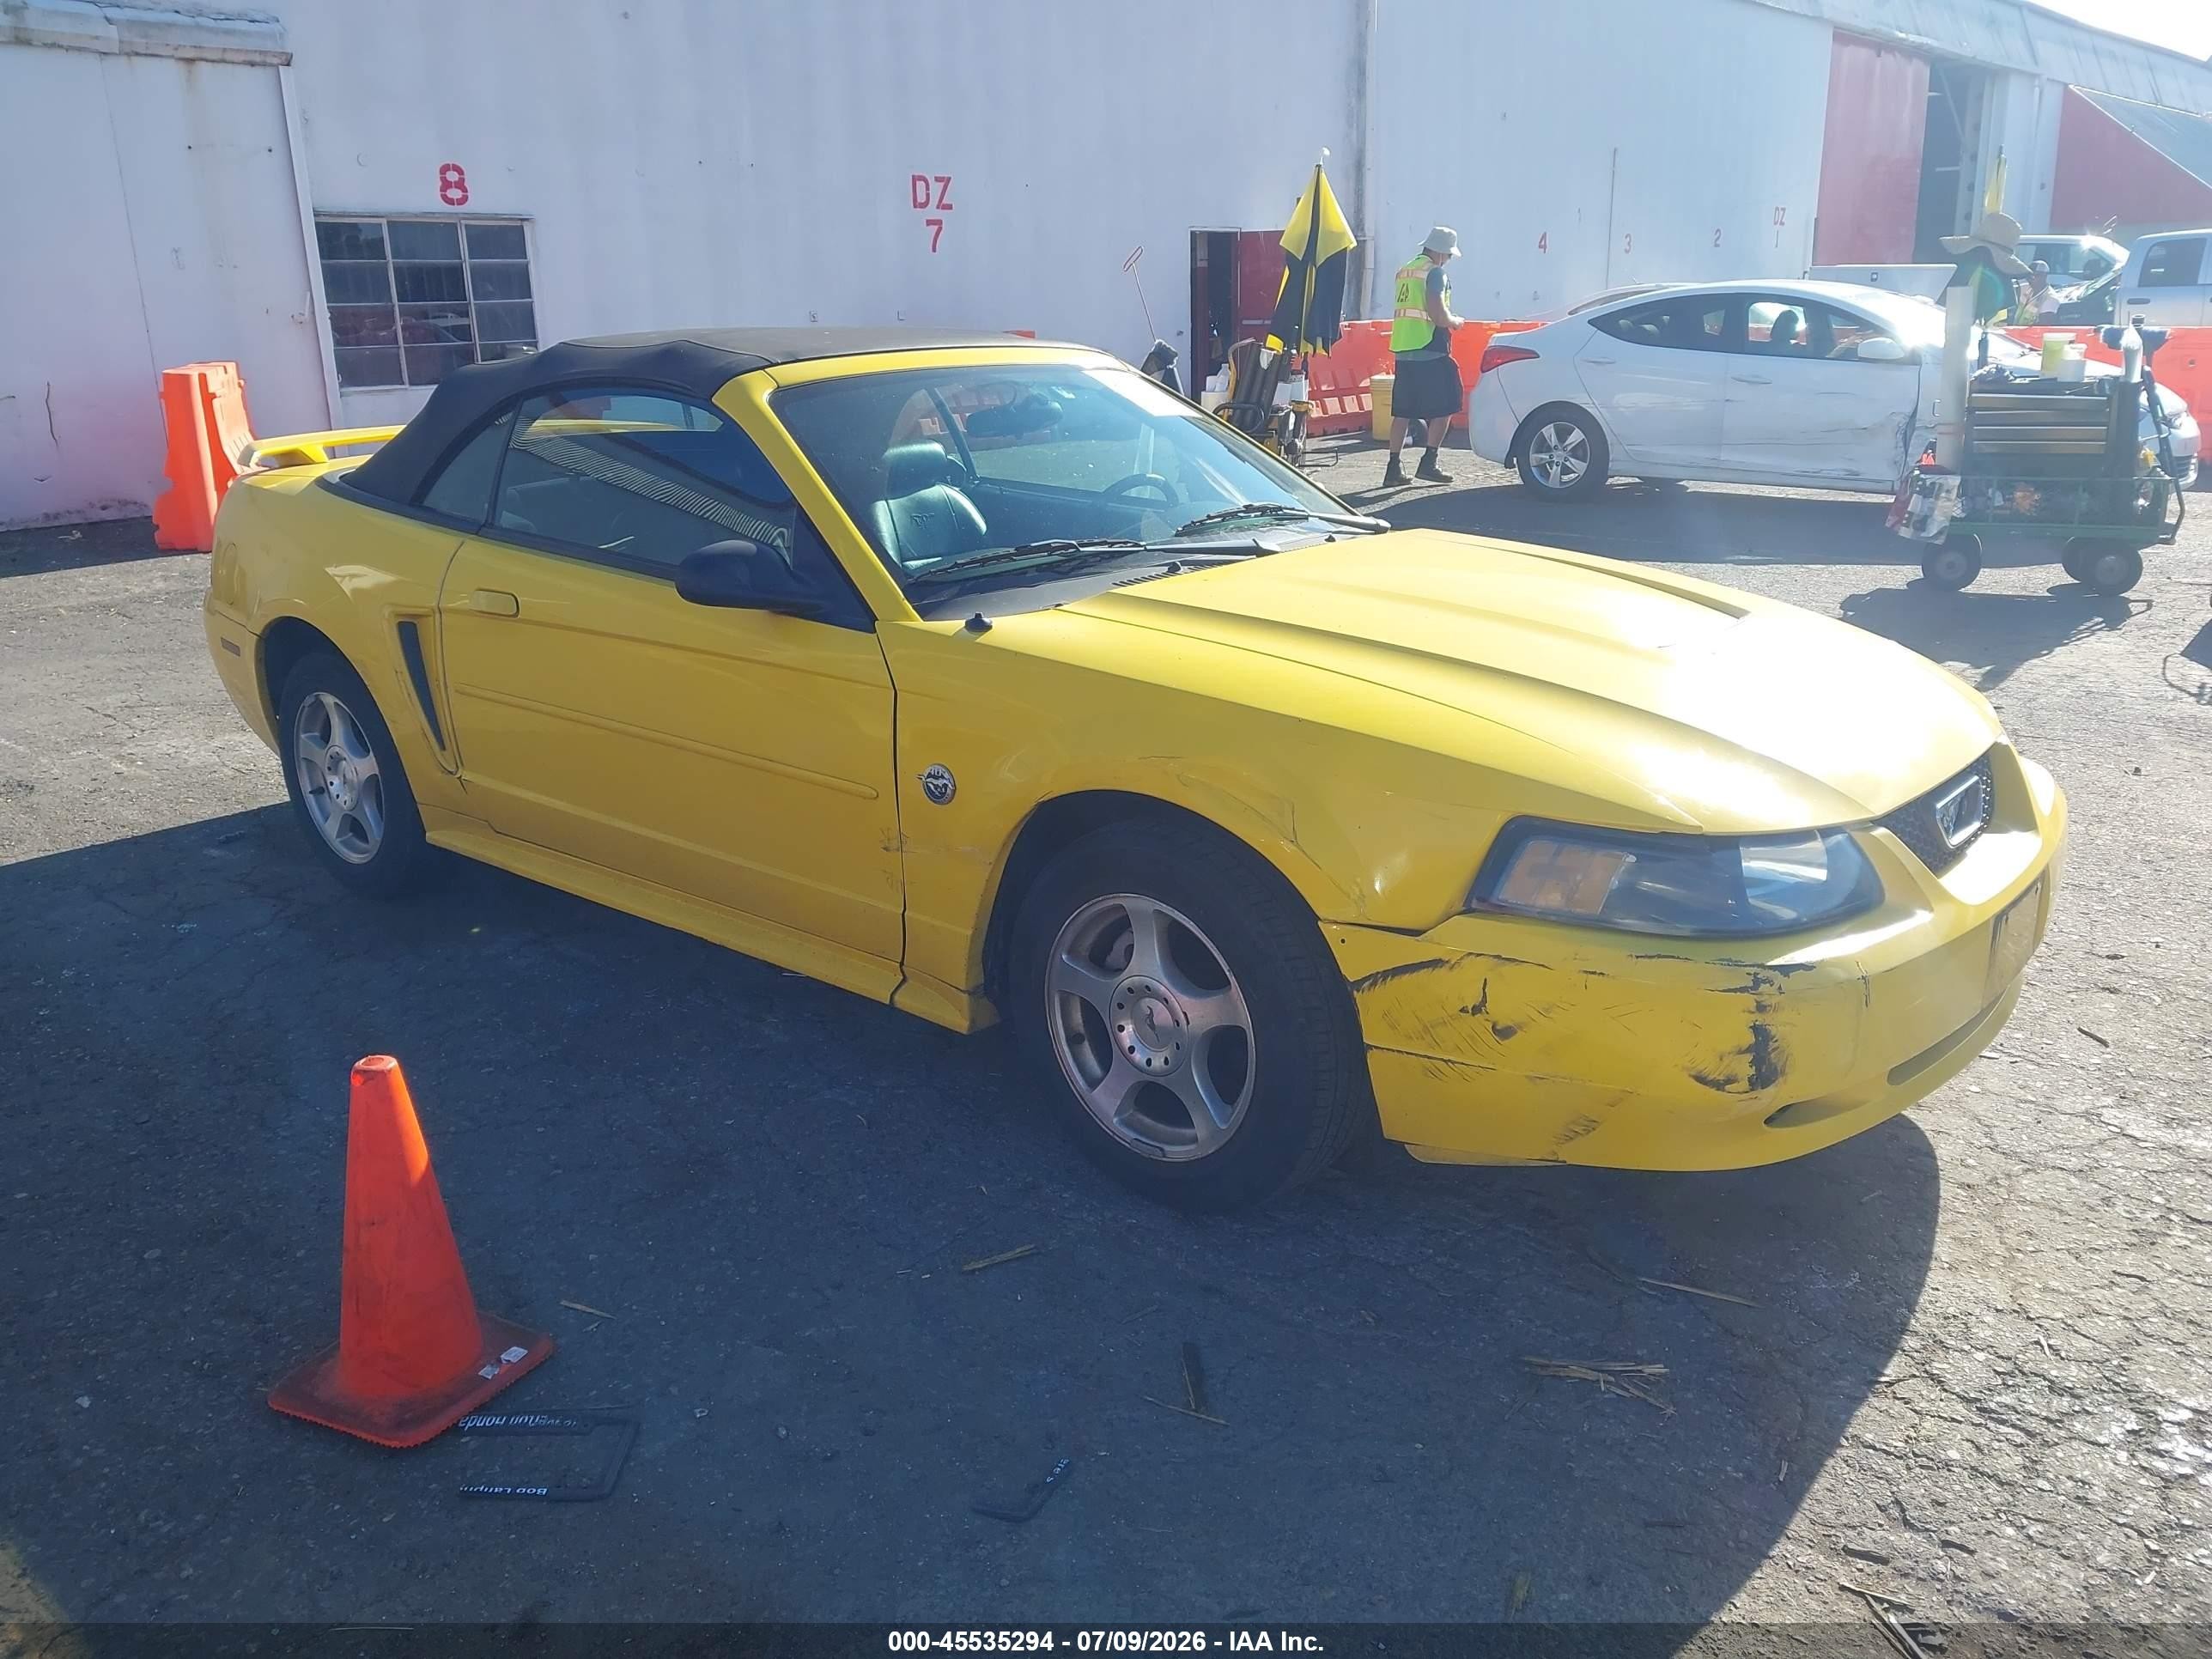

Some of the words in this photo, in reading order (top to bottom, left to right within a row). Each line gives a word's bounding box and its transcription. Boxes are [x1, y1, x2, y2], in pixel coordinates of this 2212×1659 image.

[439, 163, 469, 206] 8
[912, 174, 953, 210] DZ
[1773, 206, 1787, 226] DZ
[926, 219, 943, 253] 7
[1538, 231, 1547, 253] 4
[1625, 233, 1632, 253] 3
[1714, 228, 1722, 247] 2
